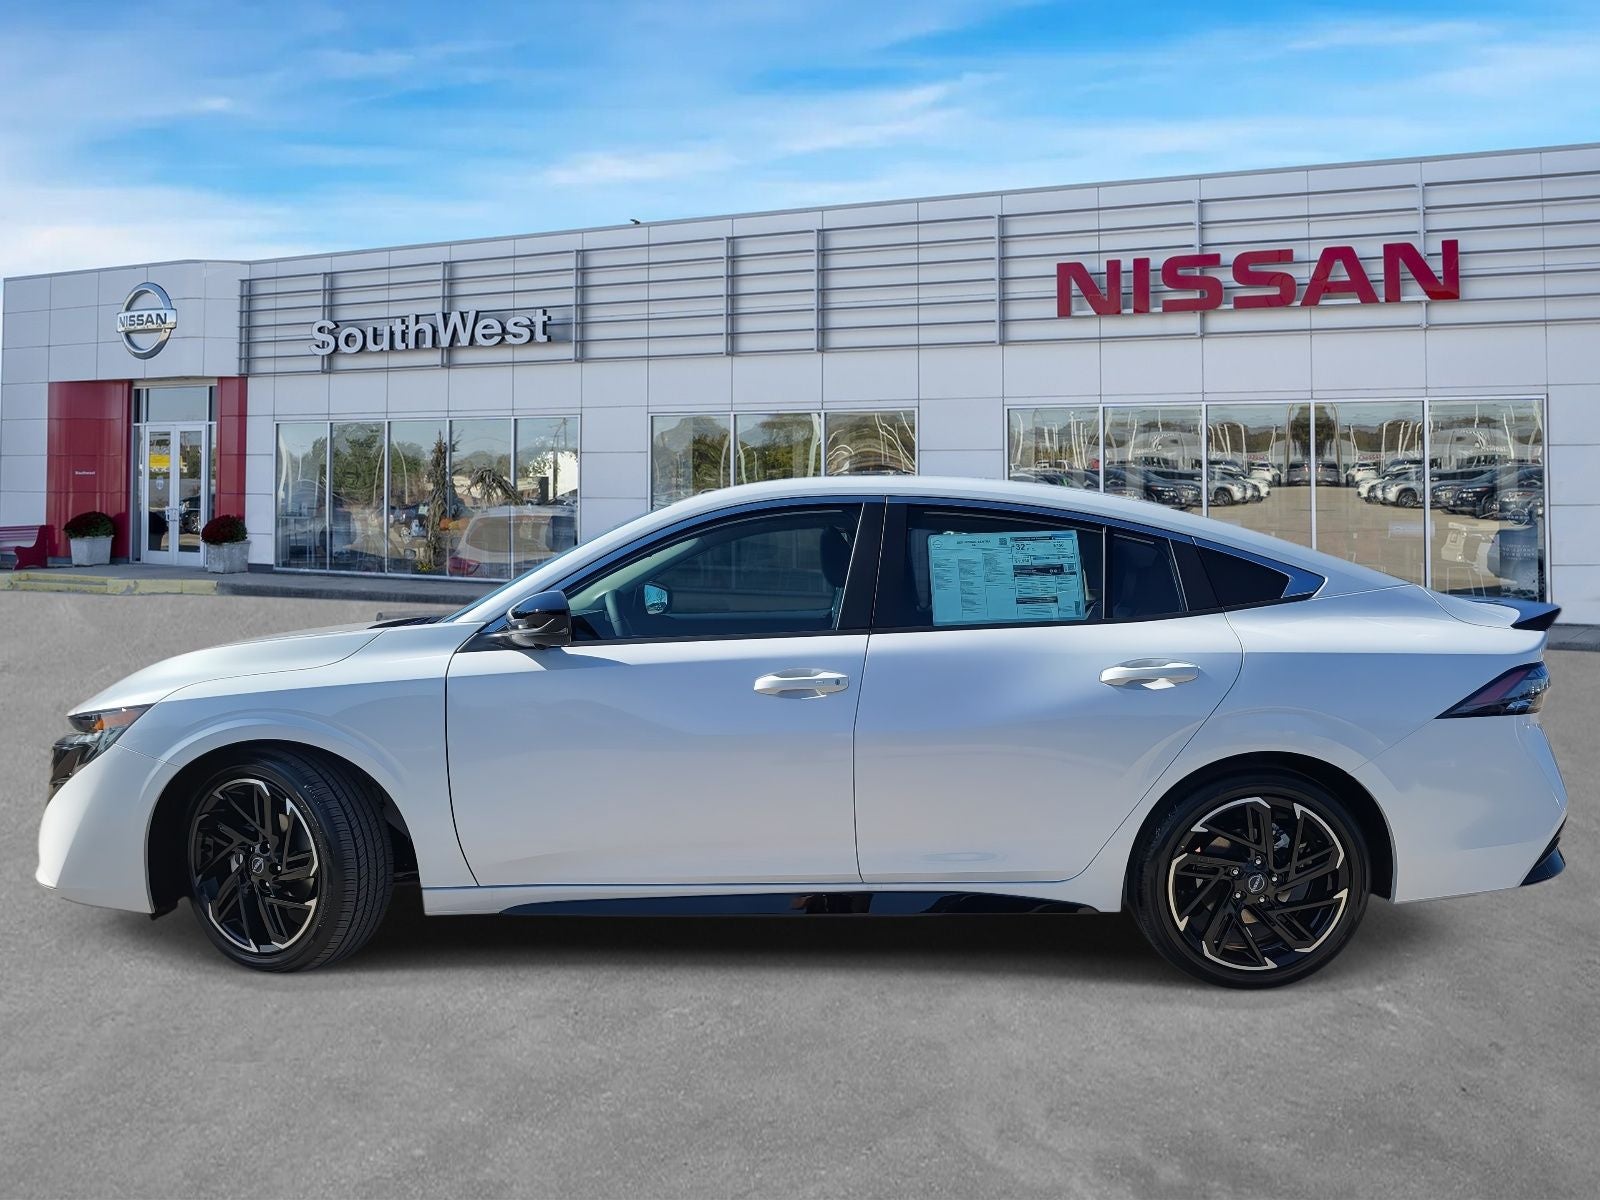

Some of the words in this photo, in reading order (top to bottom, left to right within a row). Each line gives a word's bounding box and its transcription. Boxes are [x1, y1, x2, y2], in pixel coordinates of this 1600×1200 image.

[1056, 239, 1460, 318] NISSAN
[119, 312, 168, 329] NISSAN
[309, 308, 552, 356] SouthWest
